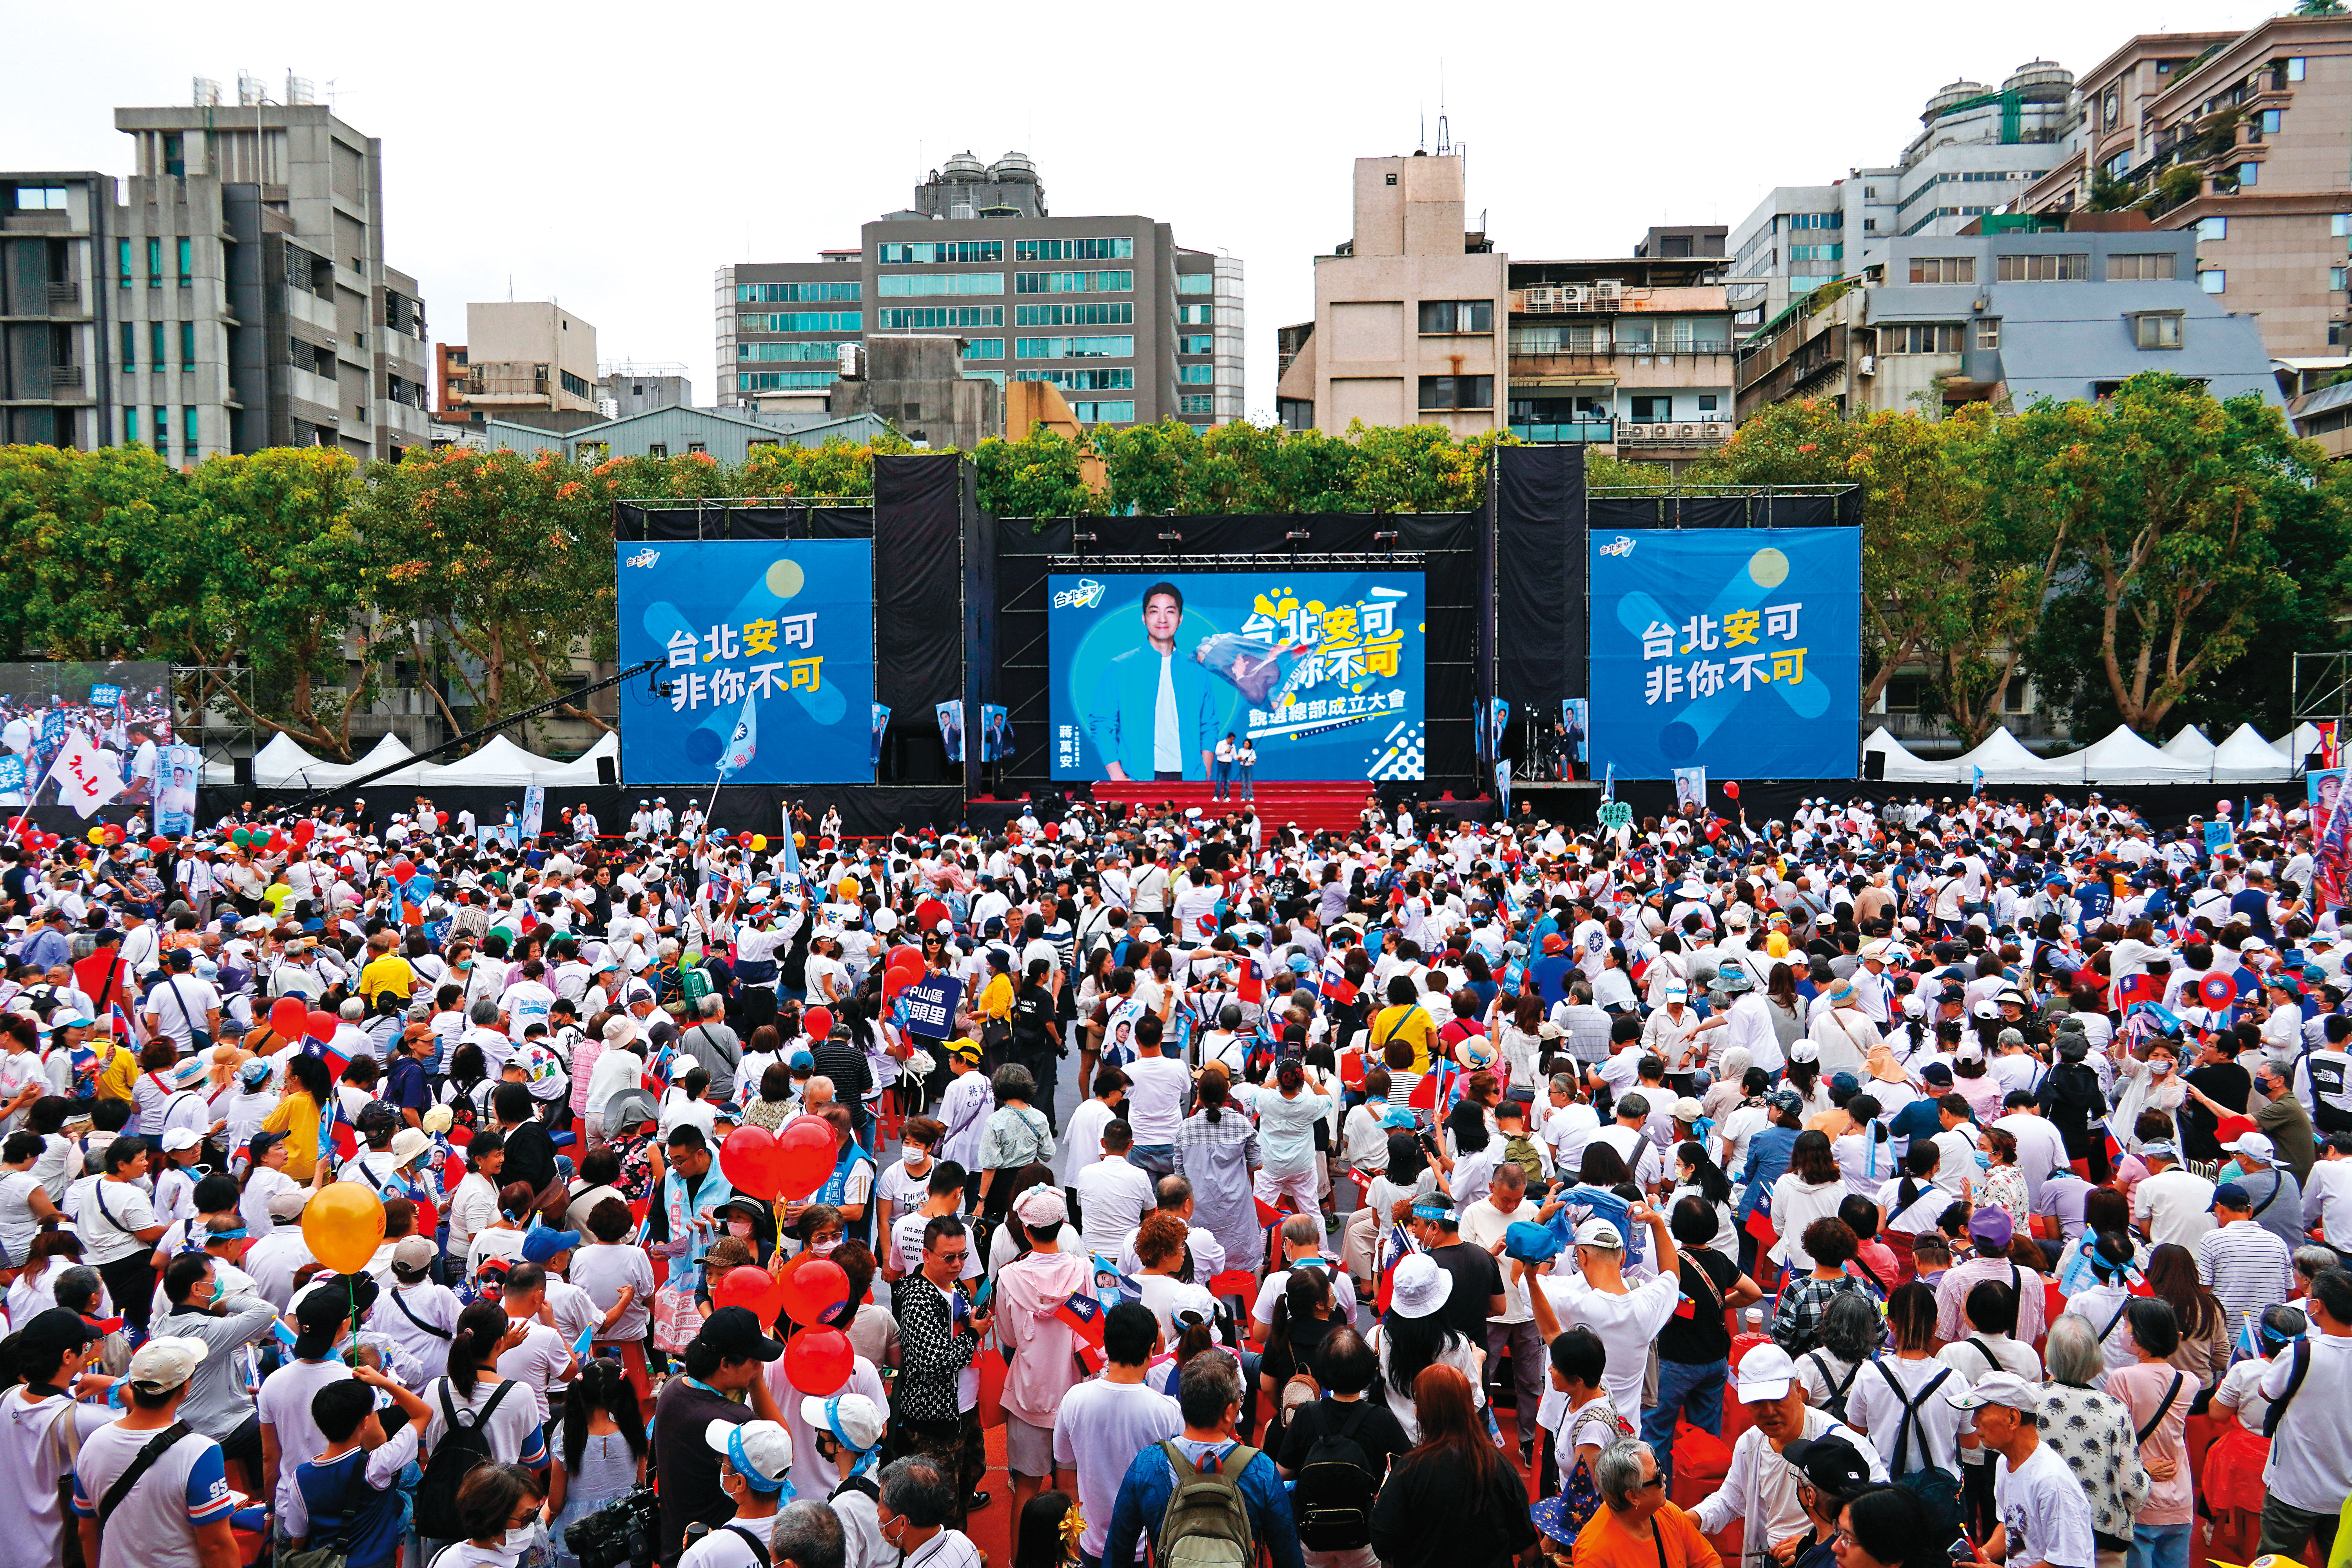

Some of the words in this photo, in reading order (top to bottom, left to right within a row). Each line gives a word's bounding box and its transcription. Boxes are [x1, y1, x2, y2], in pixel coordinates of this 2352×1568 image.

[1055, 588, 1097, 606] 台北安可
[666, 612, 818, 669] 台北安可
[1641, 603, 1806, 661] 台北安可
[670, 656, 824, 713] 非你不可
[1644, 647, 1812, 705] 非你不可
[1059, 725, 1073, 768] 蔣萬安
[903, 1192, 915, 1202] THE
